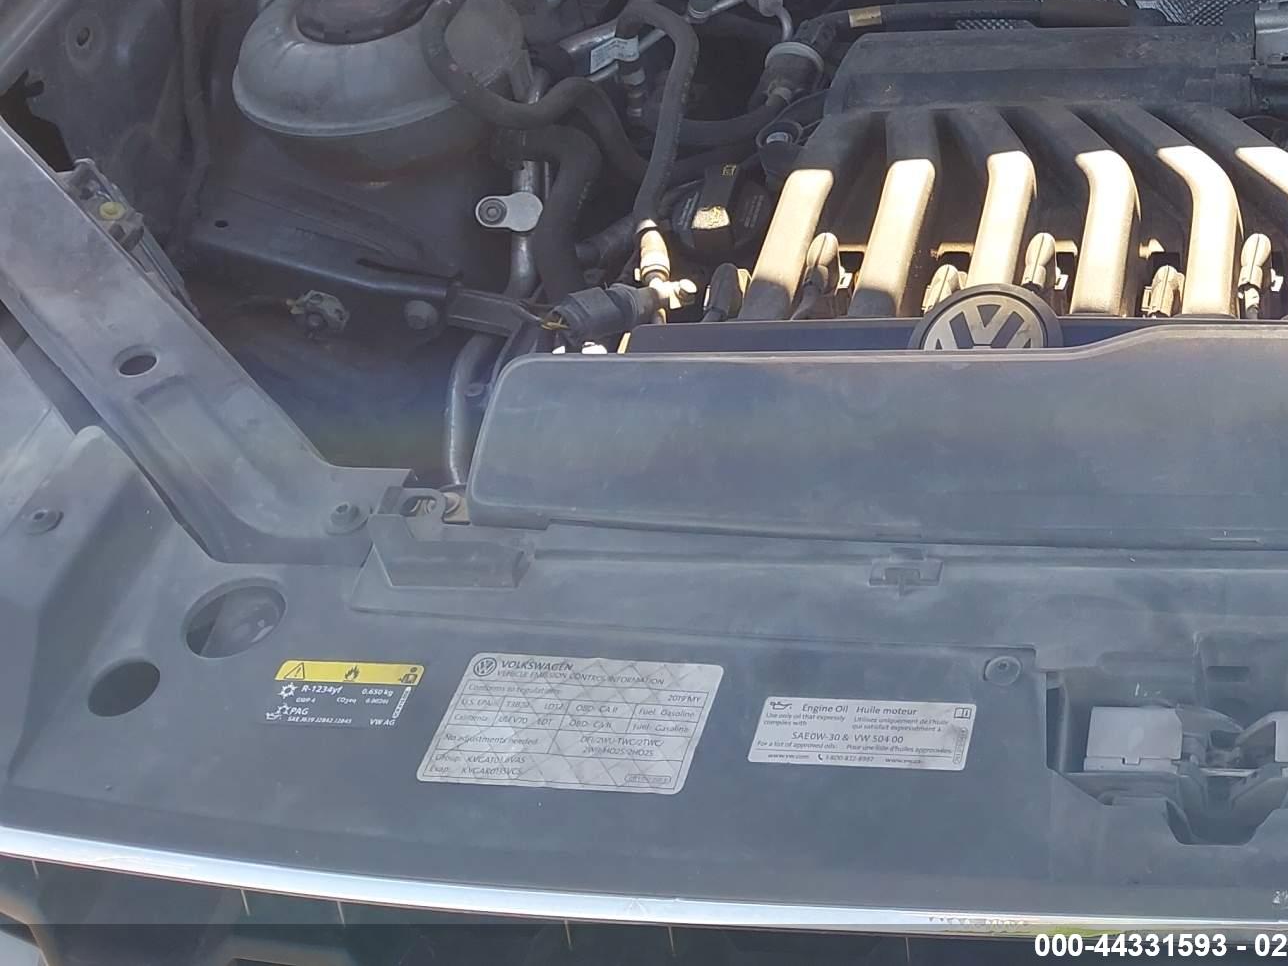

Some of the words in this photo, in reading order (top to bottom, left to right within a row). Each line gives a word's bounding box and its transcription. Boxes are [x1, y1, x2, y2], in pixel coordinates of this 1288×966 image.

[501, 660, 574, 671] VOLKSWAGEN
[530, 671, 568, 679] EMISSION
[569, 672, 606, 681] CONTROL
[607, 675, 665, 684] INFORMATION
[301, 685, 343, 695] R-1234yf
[362, 688, 383, 696] 0.650
[384, 689, 394, 697] kg
[290, 707, 310, 715] PAG
[661, 709, 696, 718] Gasoline
[802, 704, 832, 714] Engine
[835, 705, 849, 713] Oil
[856, 706, 883, 715] Huile
[457, 735, 506, 744] adjustments
[510, 737, 538, 745] needed
[854, 734, 870, 742] VW
[872, 735, 890, 743] 504
